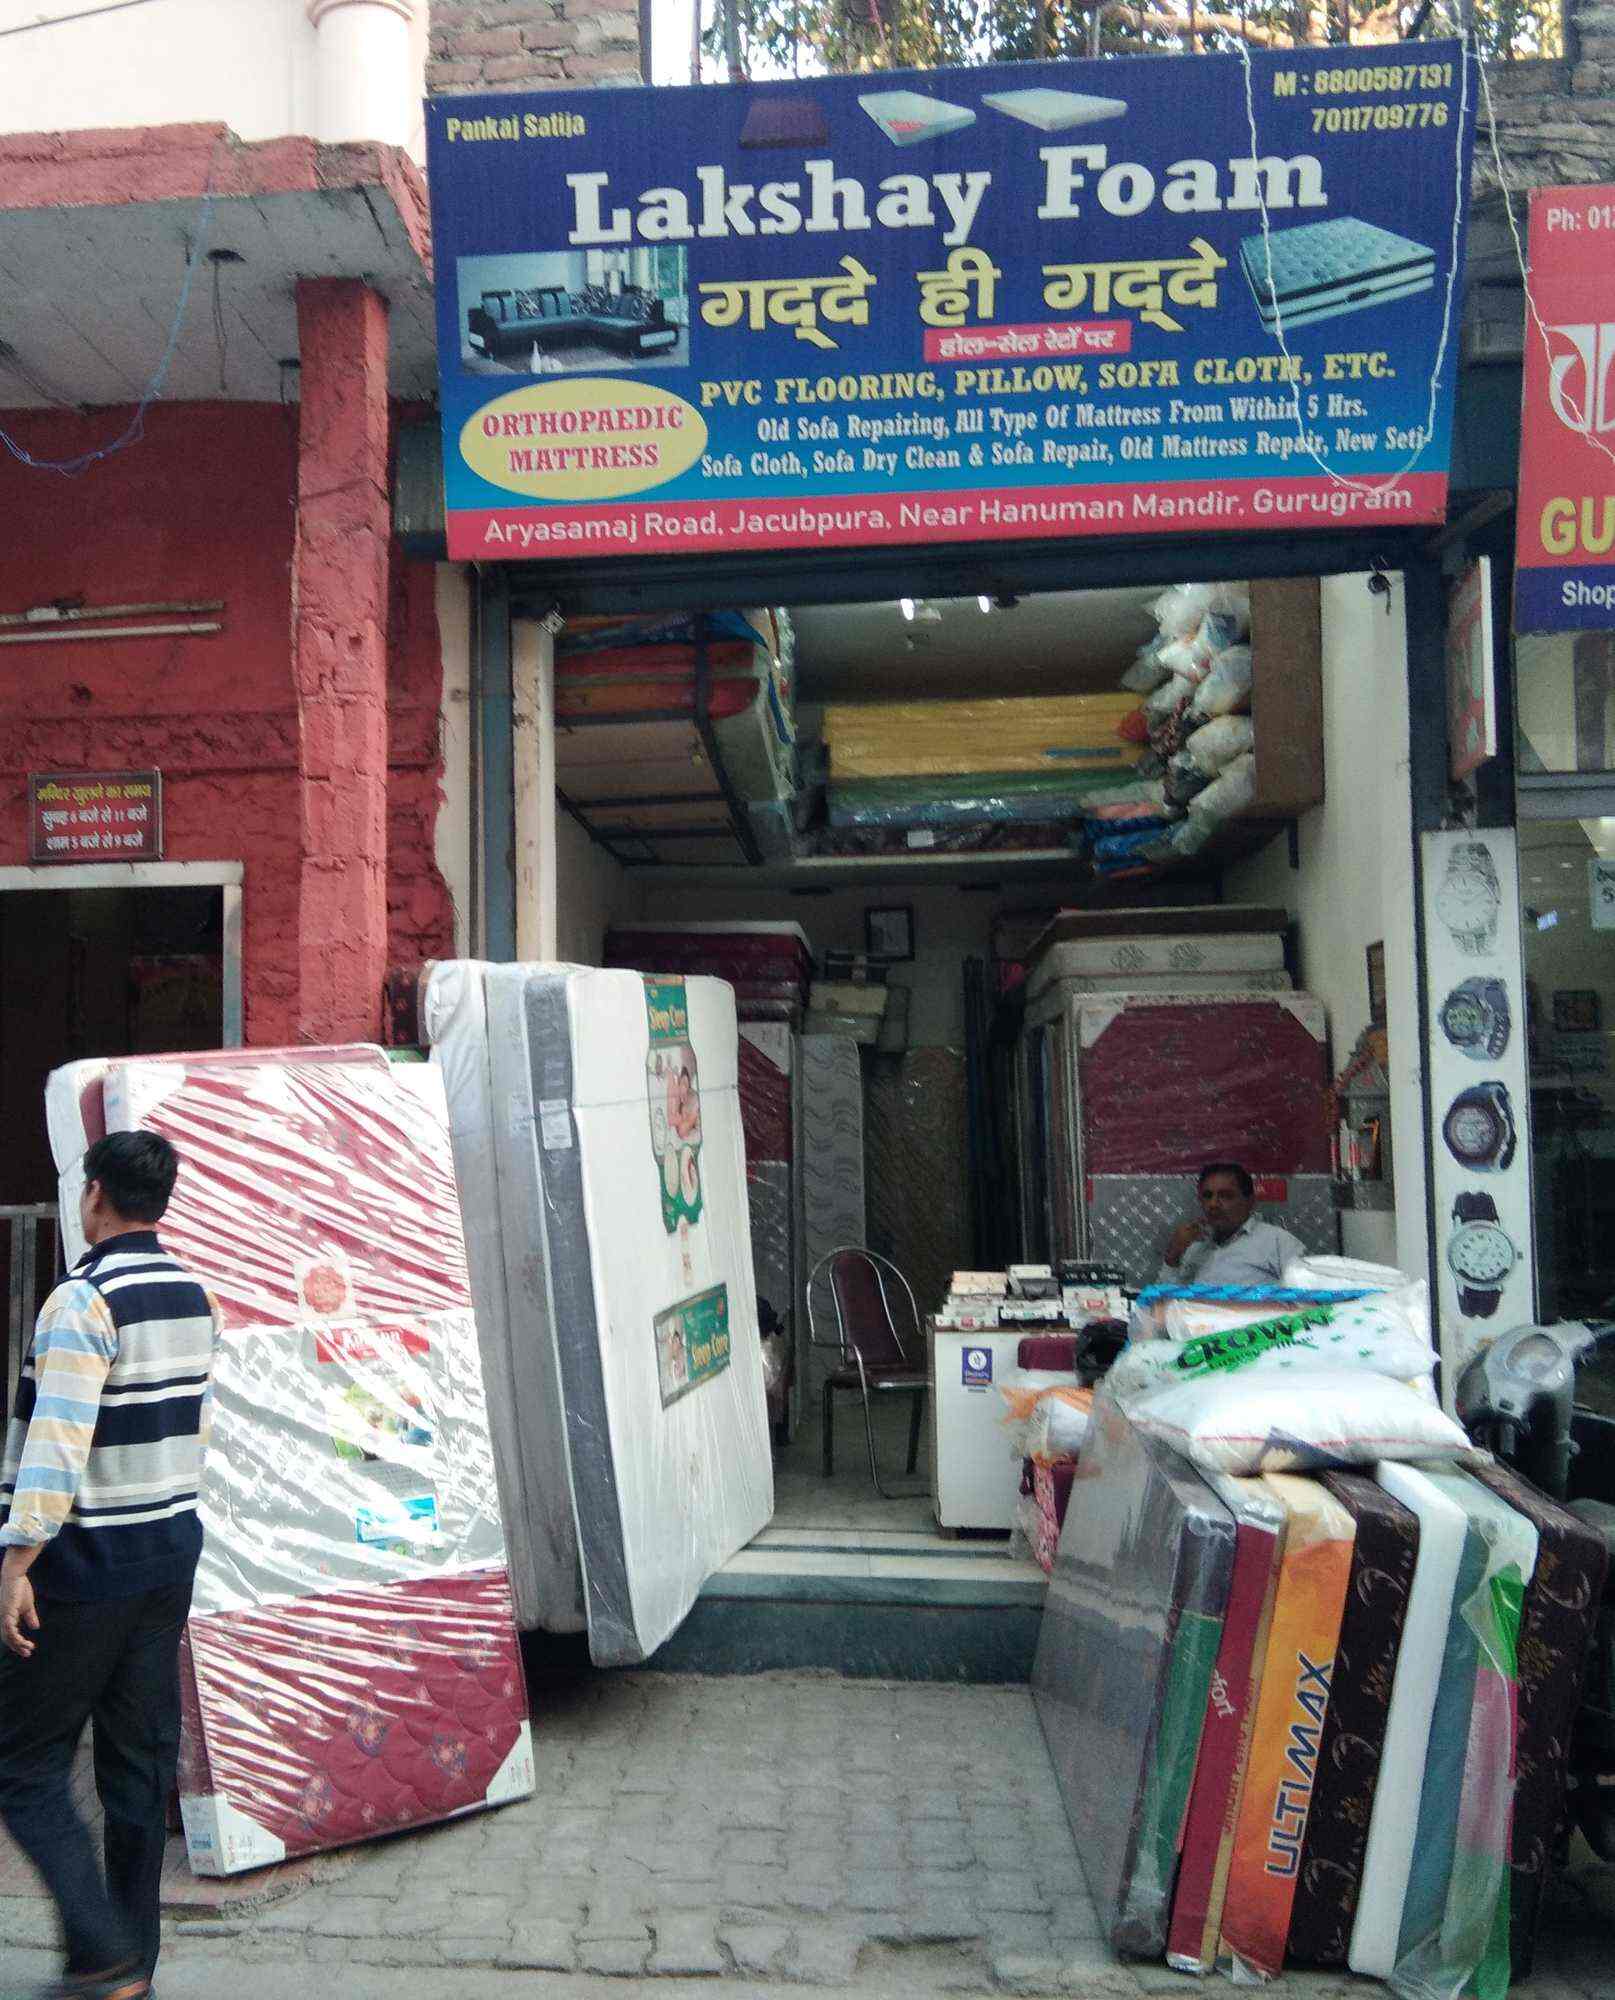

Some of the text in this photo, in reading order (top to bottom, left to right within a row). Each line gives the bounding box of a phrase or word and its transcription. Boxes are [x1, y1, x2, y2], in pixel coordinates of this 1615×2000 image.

[446, 111, 586, 143] Pankaj Satija
[1311, 101, 1448, 134] 7011709776
[565, 143, 1329, 247] Lakshay Foam
[1546, 204, 1615, 233] Ph: 01
[916, 246, 1001, 327] ही
[1083, 328, 1118, 349] पर
[699, 351, 1396, 408] PVC FLOORING, PILLOW, SOFA CLOTH, ETC.
[481, 405, 684, 439] ORTHOPAEDIC
[756, 393, 1369, 444] Old Sofa Repairing, All Type Of Mattress From Within 5 Hrs.
[508, 442, 659, 473] MATTRESS
[701, 453, 743, 479] Sofa
[750, 451, 808, 479] Cloth,
[813, 448, 855, 475] Sofa
[862, 447, 899, 477] Dry
[905, 444, 960, 471] Clean
[968, 442, 985, 468] &
[991, 441, 1034, 467] Sofa
[1042, 437, 1114, 469] Repair,
[1119, 436, 1154, 461] Old
[1161, 433, 1248, 460] Mattress
[1256, 428, 1329, 461] Repair,
[1334, 426, 1378, 453] New
[483, 512, 639, 546] Aryasamaj
[899, 501, 973, 529] Near
[979, 493, 1124, 524] Hanuman
[1253, 488, 1413, 517] Gurugram
[1264, 1649, 1336, 1880] ULTIMAX
